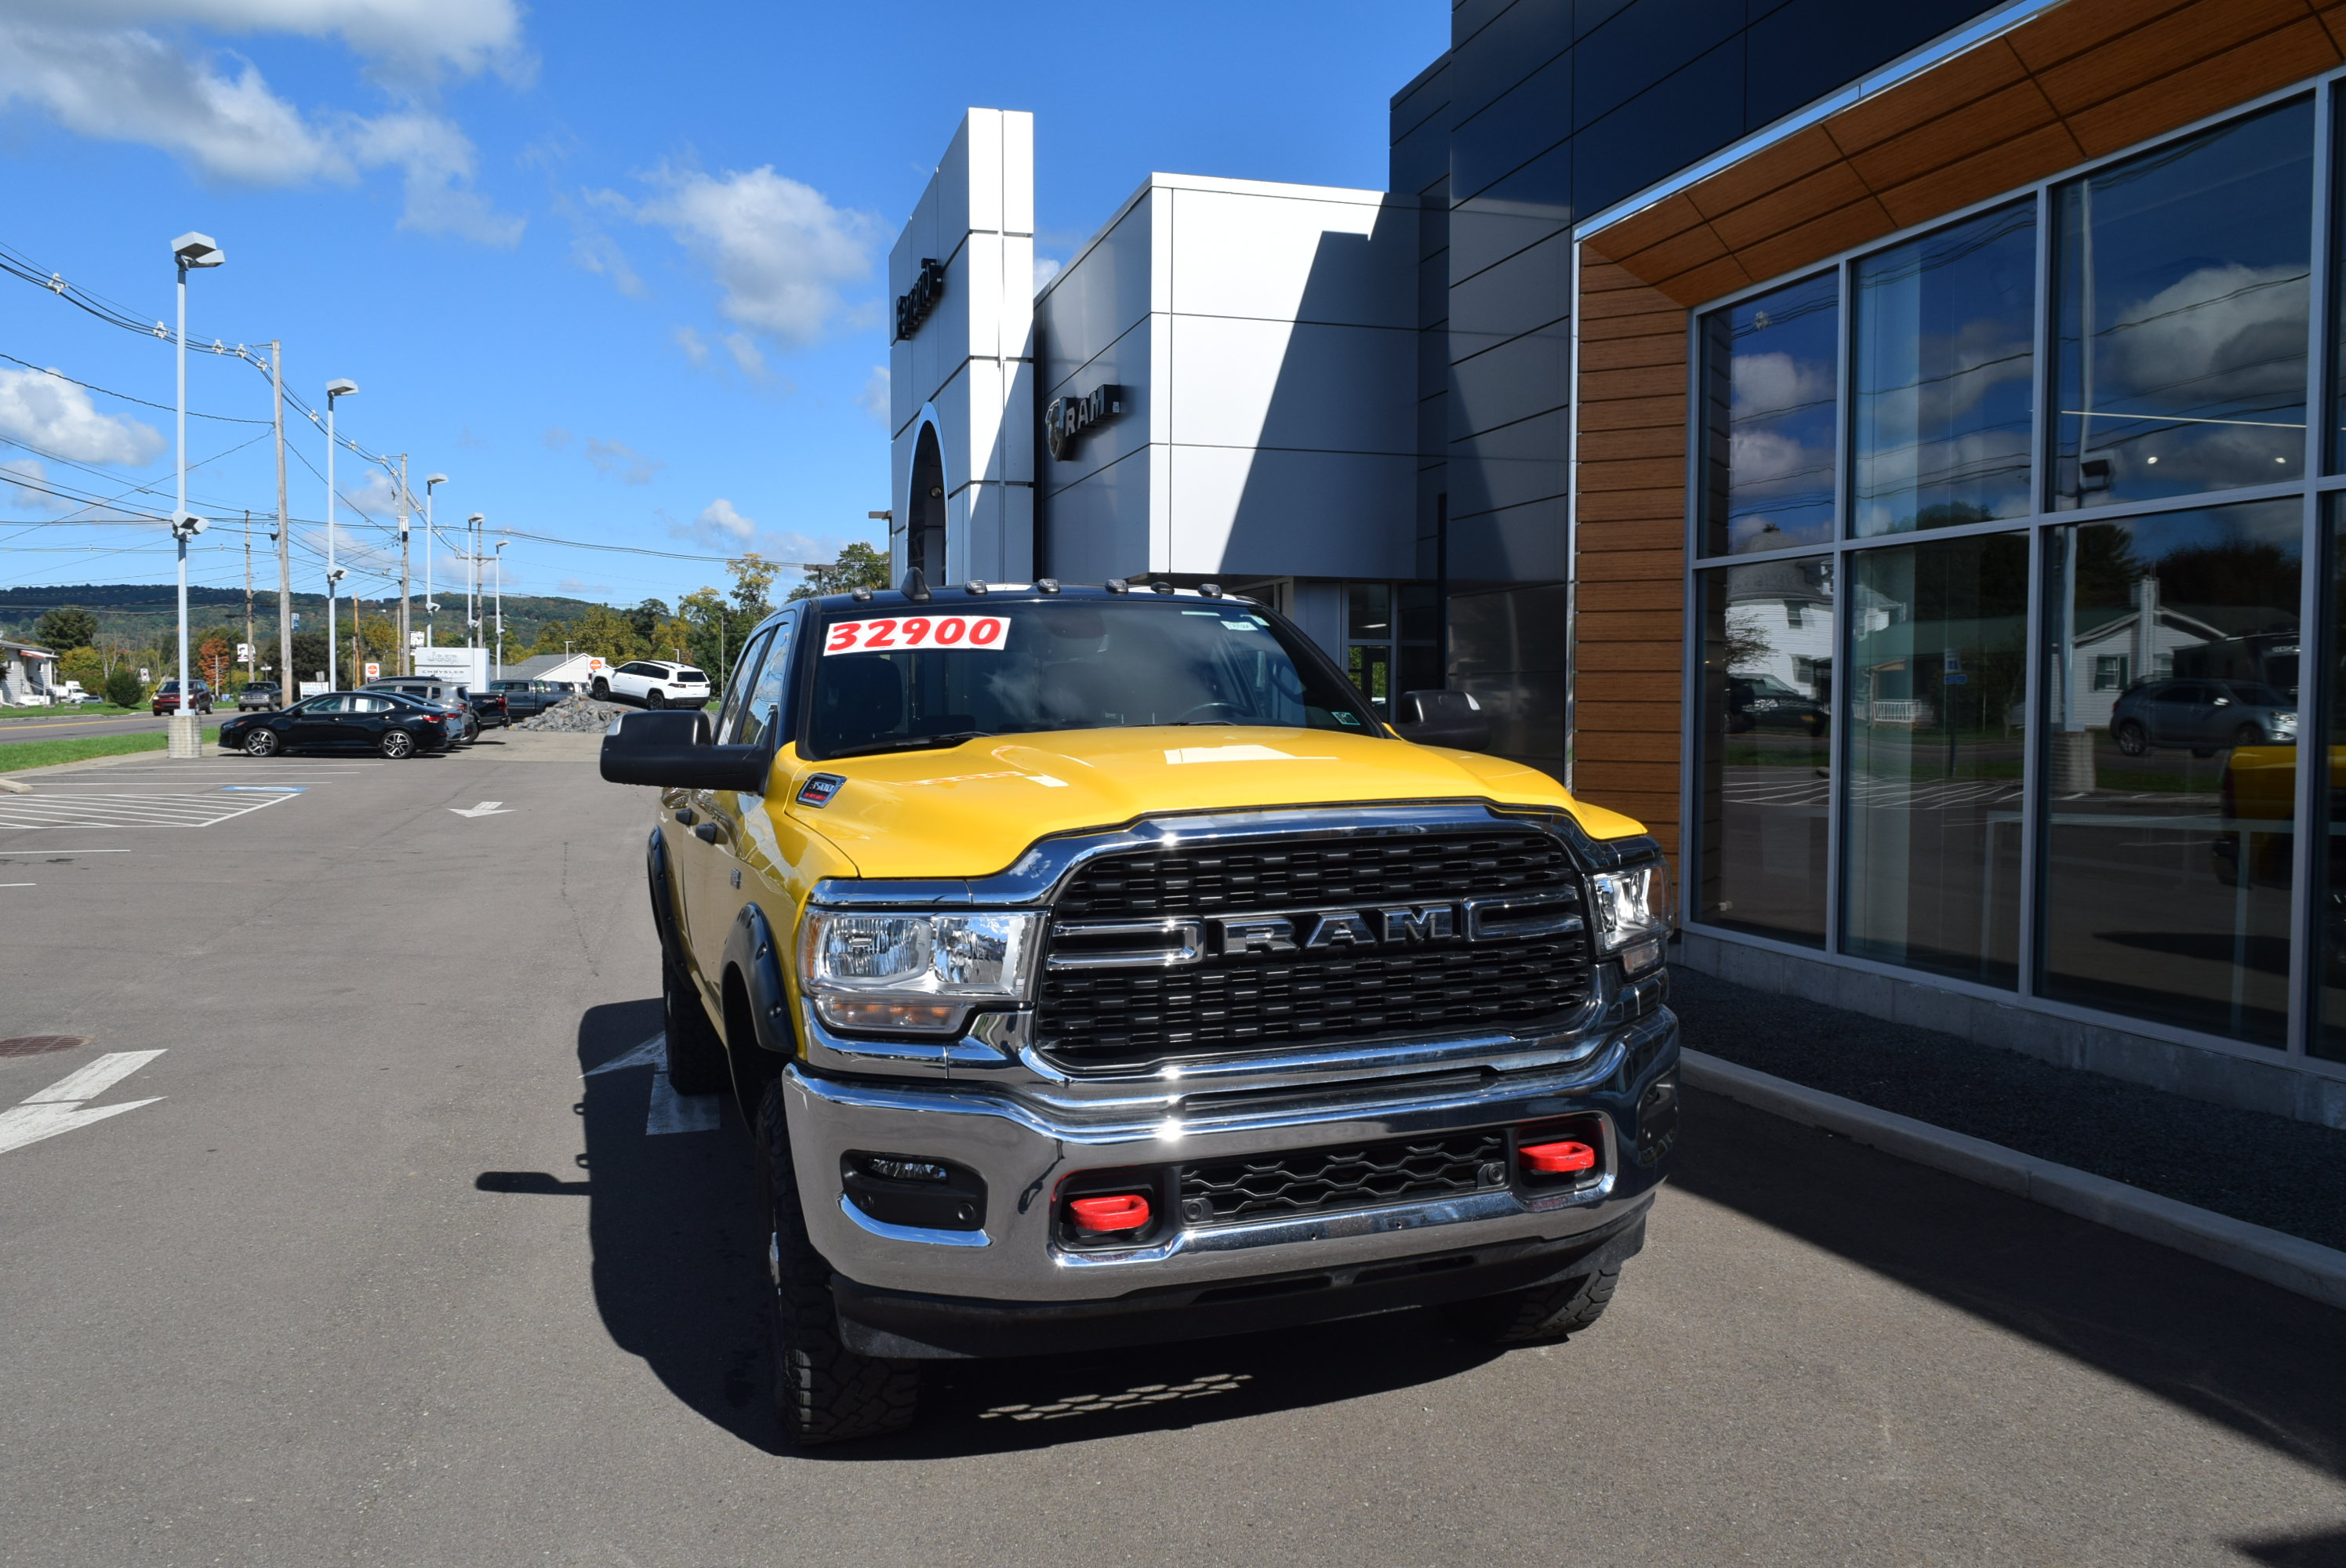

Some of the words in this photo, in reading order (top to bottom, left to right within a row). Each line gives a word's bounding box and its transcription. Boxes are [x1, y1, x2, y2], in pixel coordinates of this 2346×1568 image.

[1066, 384, 1106, 437] RAM
[827, 618, 1002, 652] 32900
[427, 652, 459, 663] Jeep
[1219, 904, 1453, 955] RAM
